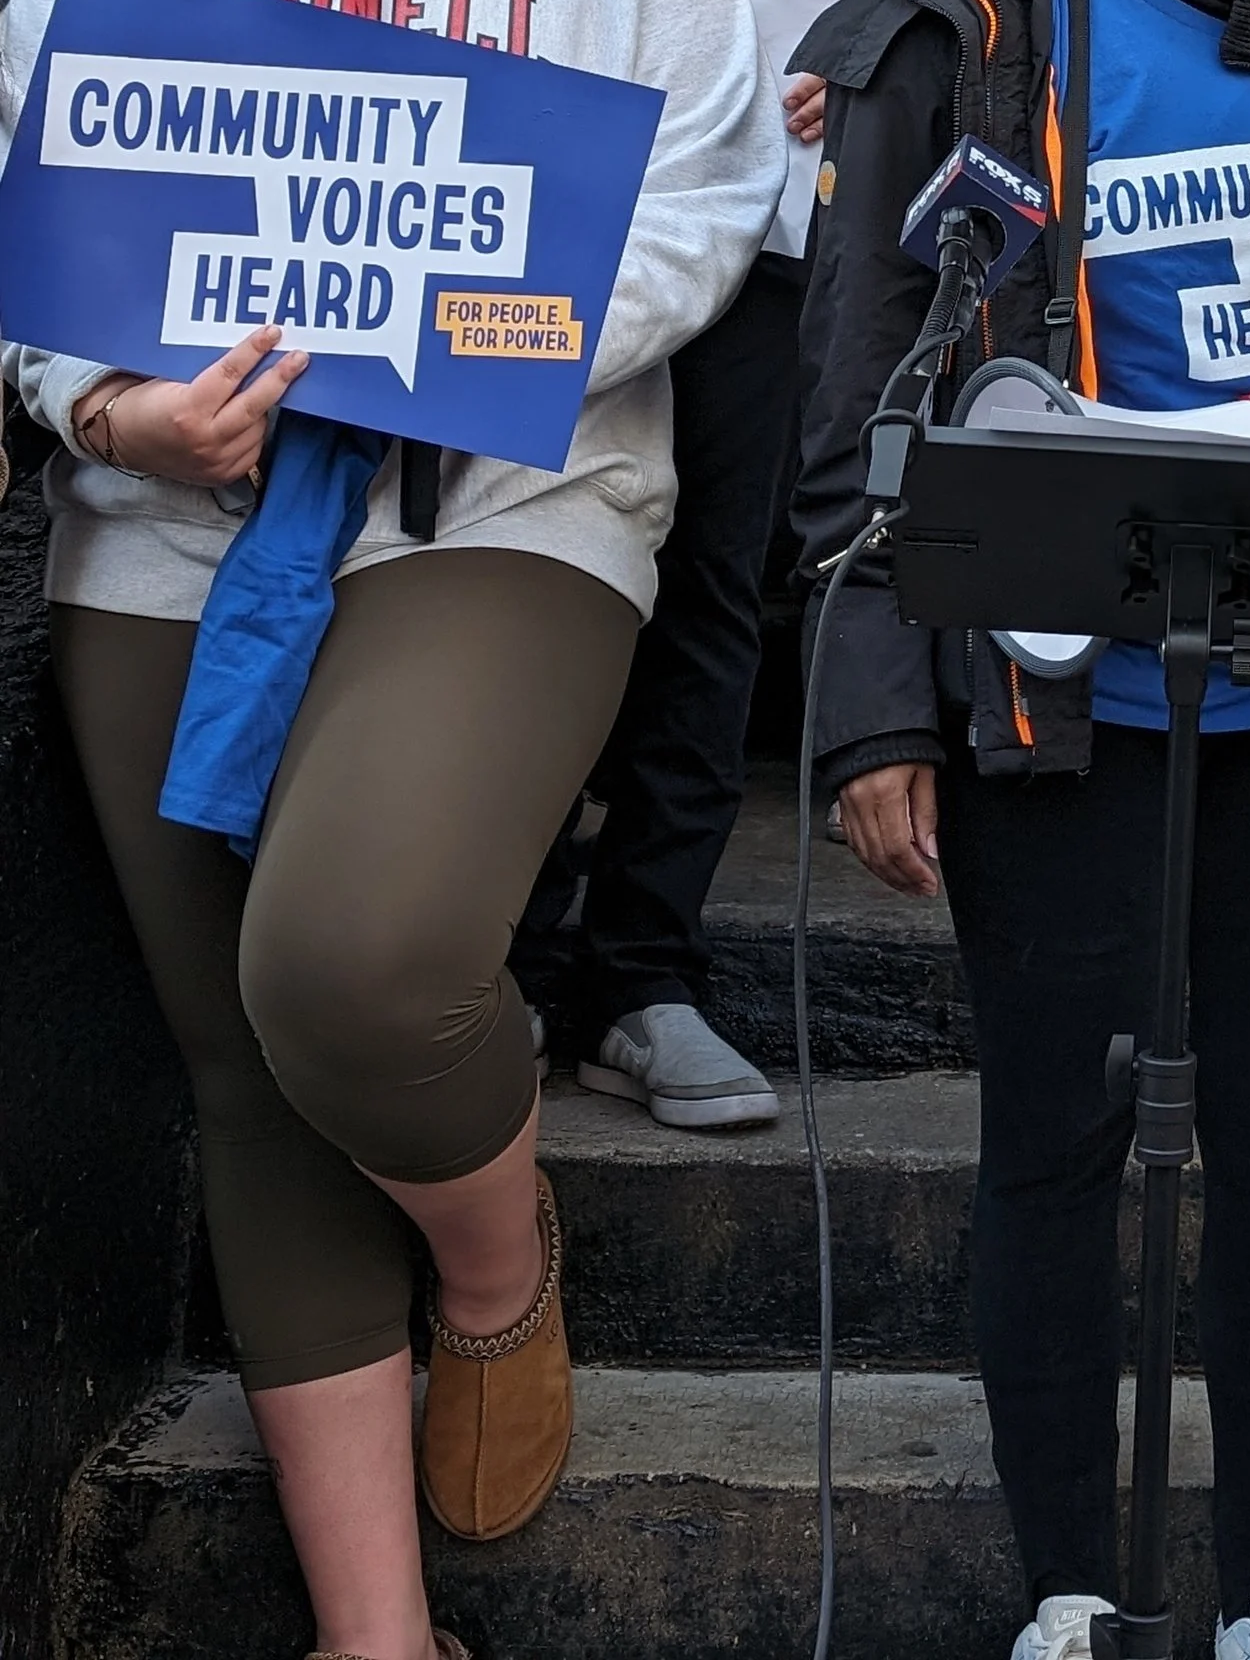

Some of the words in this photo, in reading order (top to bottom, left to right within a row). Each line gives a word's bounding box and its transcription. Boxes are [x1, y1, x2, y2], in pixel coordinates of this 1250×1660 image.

[69, 78, 443, 167] COMMUNITY
[288, 176, 505, 254] VOICES
[191, 254, 394, 330] HEARD
[446, 300, 484, 323] FOR
[488, 301, 562, 325] PEOPLE.
[461, 327, 498, 349] FOR
[503, 328, 574, 352] POWER.
